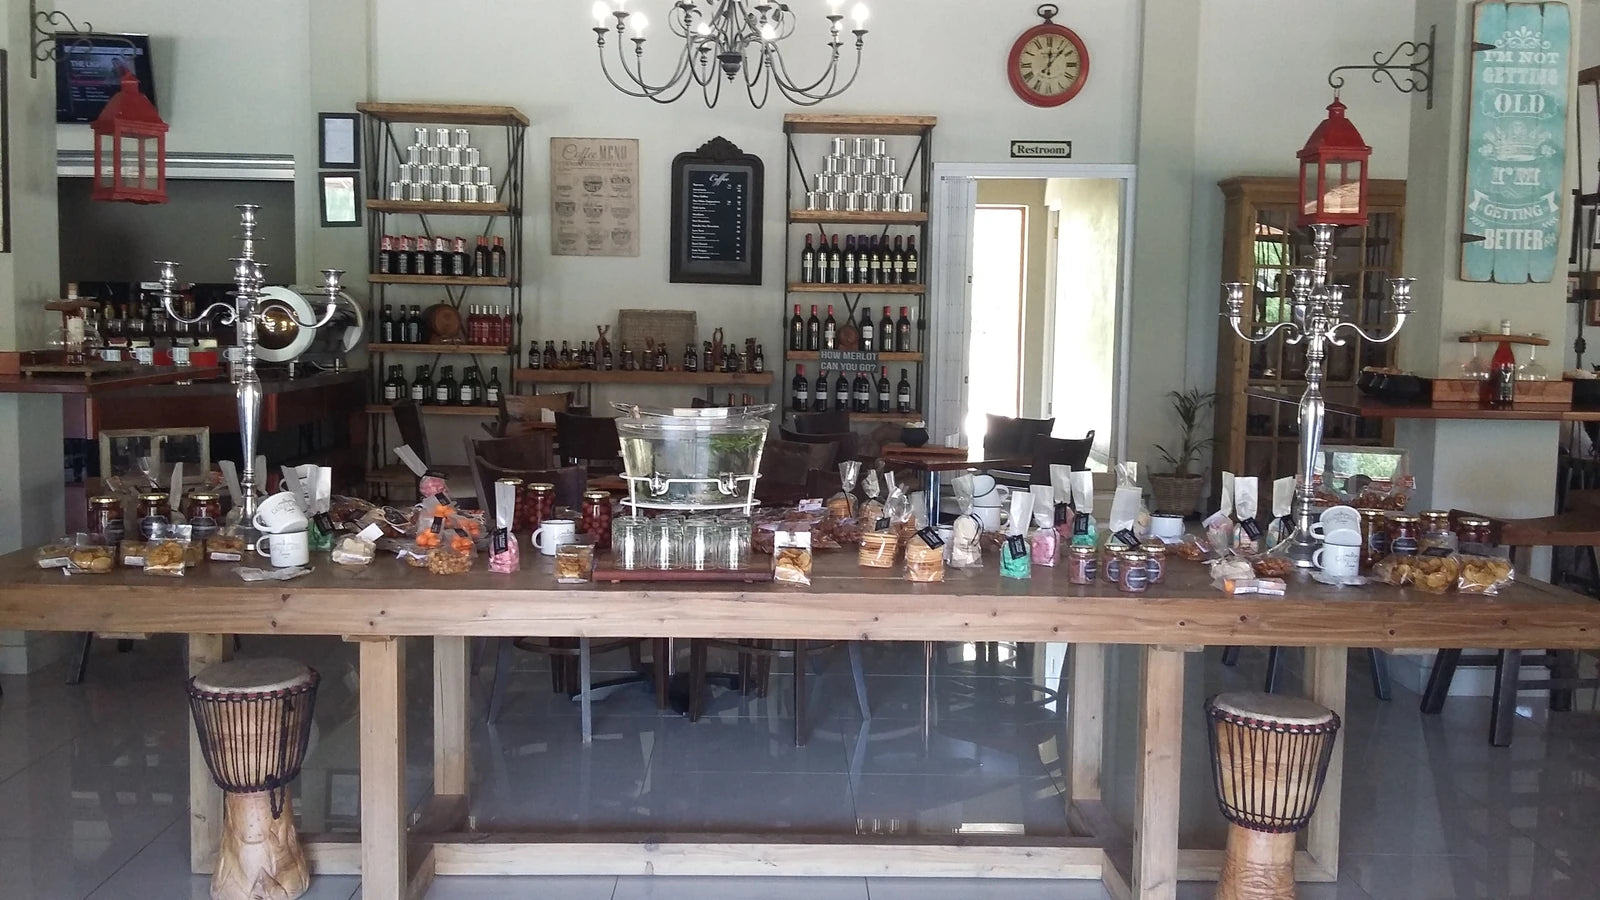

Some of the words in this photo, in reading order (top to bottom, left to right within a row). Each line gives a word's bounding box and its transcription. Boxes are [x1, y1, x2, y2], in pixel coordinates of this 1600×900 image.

[1483, 51, 1513, 62] I'M
[1518, 51, 1560, 64] NOT
[1482, 67, 1559, 85] GETTING
[1494, 94, 1546, 114] OLD
[1017, 144, 1066, 154] Restroom
[1491, 166, 1541, 185] I'M
[1484, 204, 1544, 220] GETTING
[1484, 228, 1544, 250] BETTER
[821, 350, 841, 359] HOW
[843, 351, 878, 360] MERLOT
[821, 362, 838, 370] CAN
[841, 362, 858, 371] YOU
[860, 364, 876, 372] GO?
